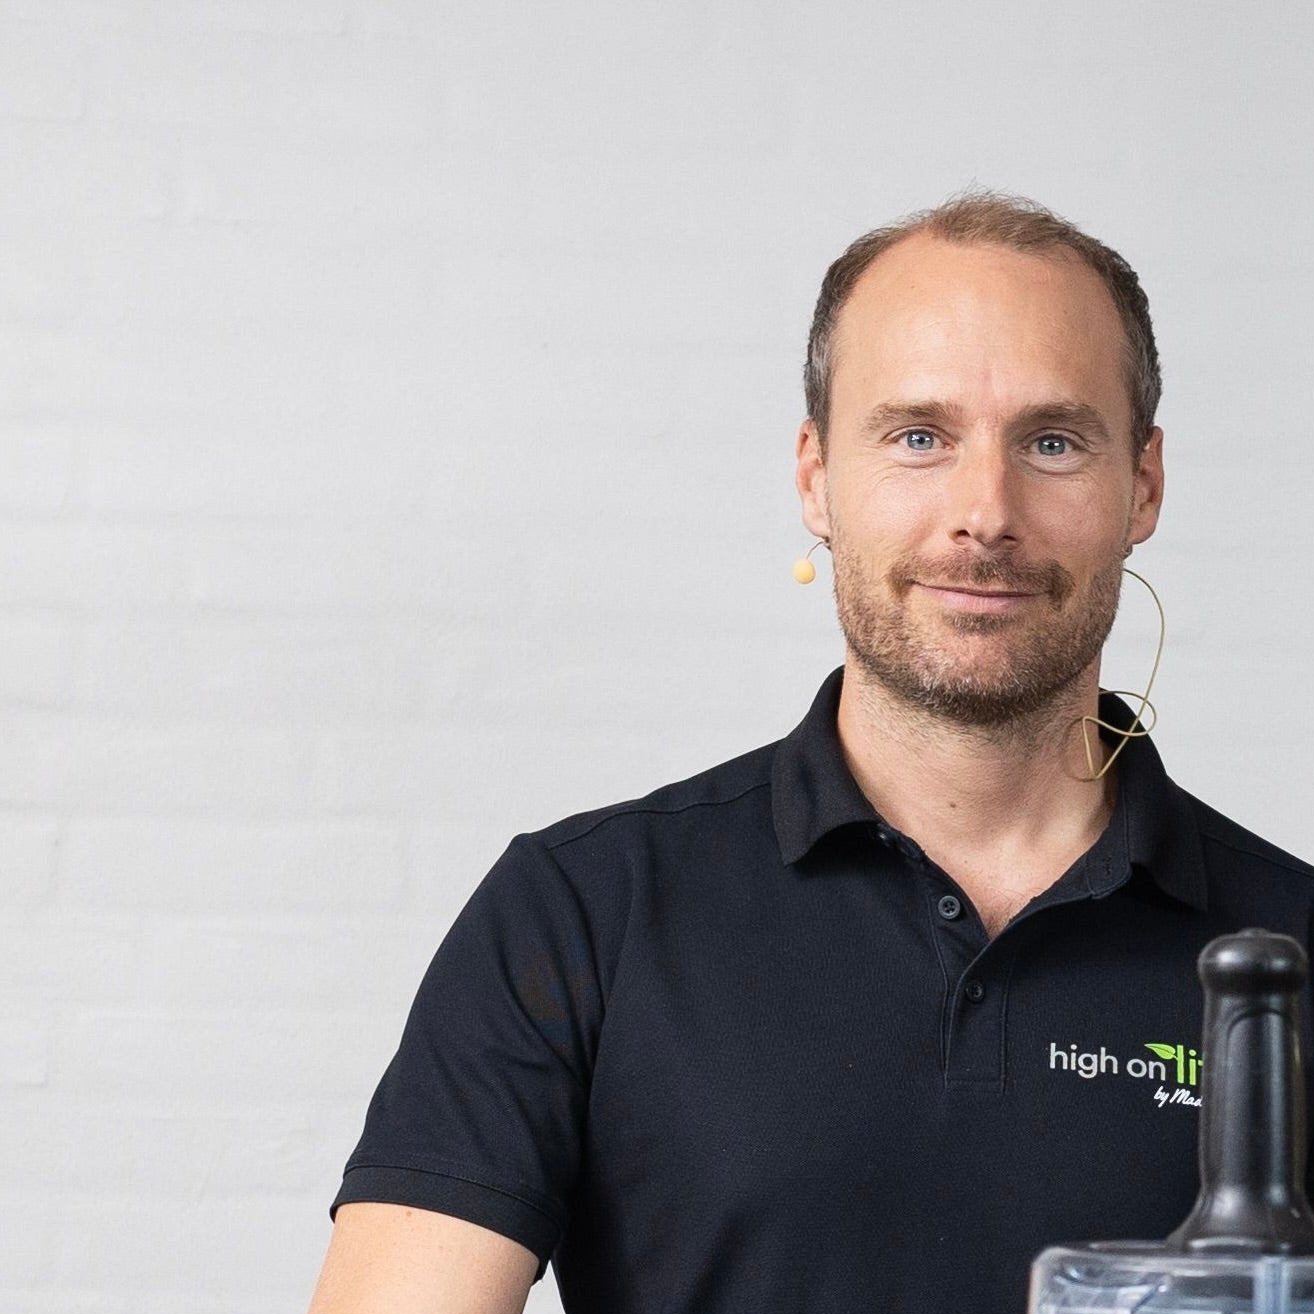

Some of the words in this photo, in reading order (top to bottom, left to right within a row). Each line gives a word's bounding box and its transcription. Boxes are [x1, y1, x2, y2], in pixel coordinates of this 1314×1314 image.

[1050, 1042, 1118, 1079] high
[1127, 1058, 1166, 1081] on
[1153, 1085, 1170, 1108] by
